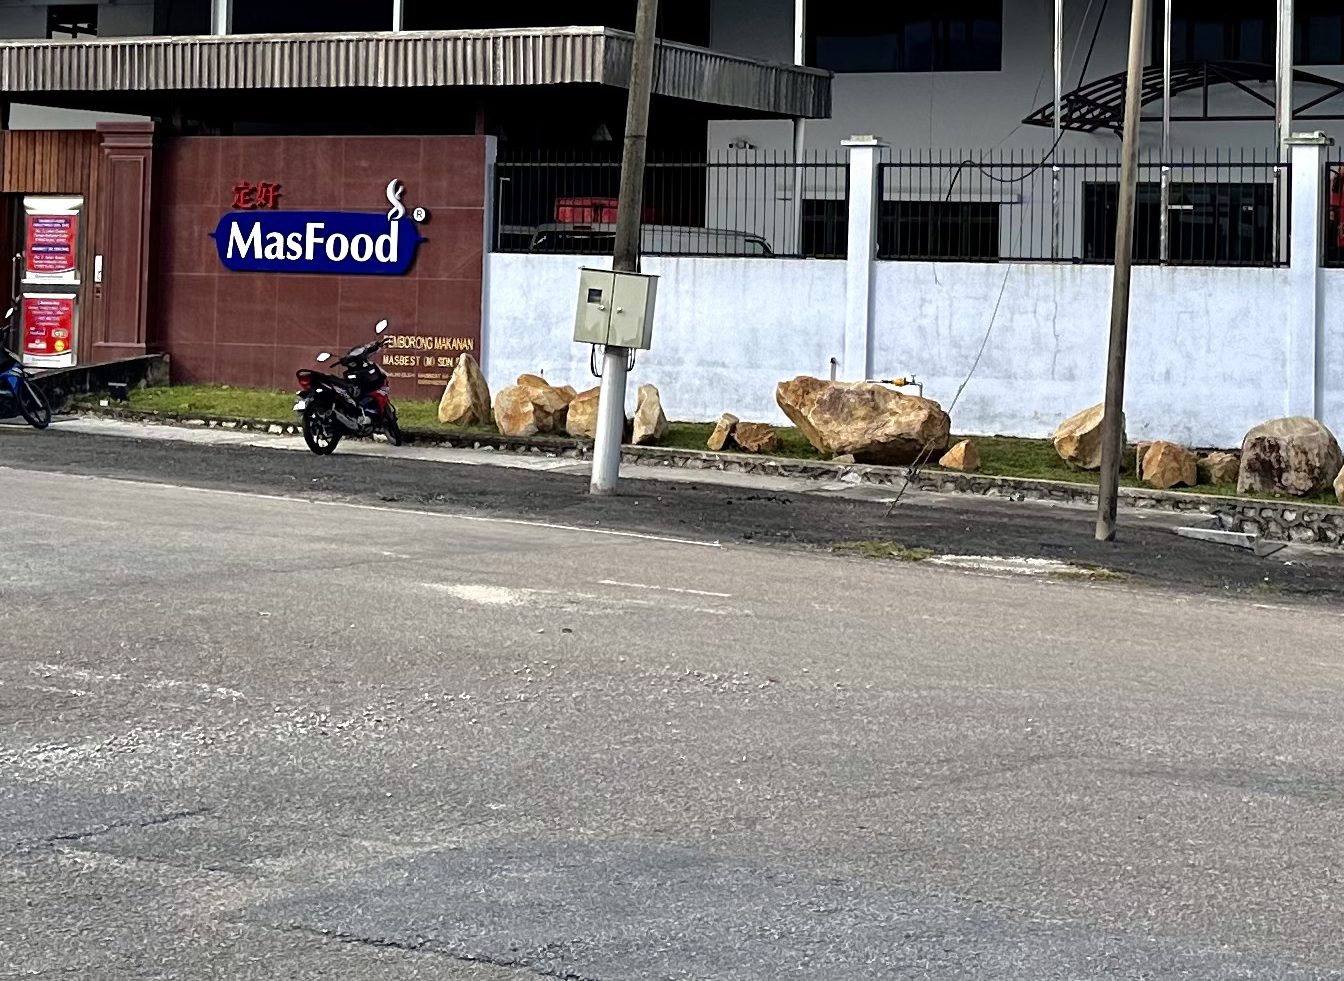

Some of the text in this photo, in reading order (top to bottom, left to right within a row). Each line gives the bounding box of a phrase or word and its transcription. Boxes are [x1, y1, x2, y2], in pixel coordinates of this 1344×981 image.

[231, 180, 281, 209] 定好
[226, 221, 399, 263] MasFood
[434, 337, 474, 351] MAKANAN
[382, 355, 421, 367] MASBEST
